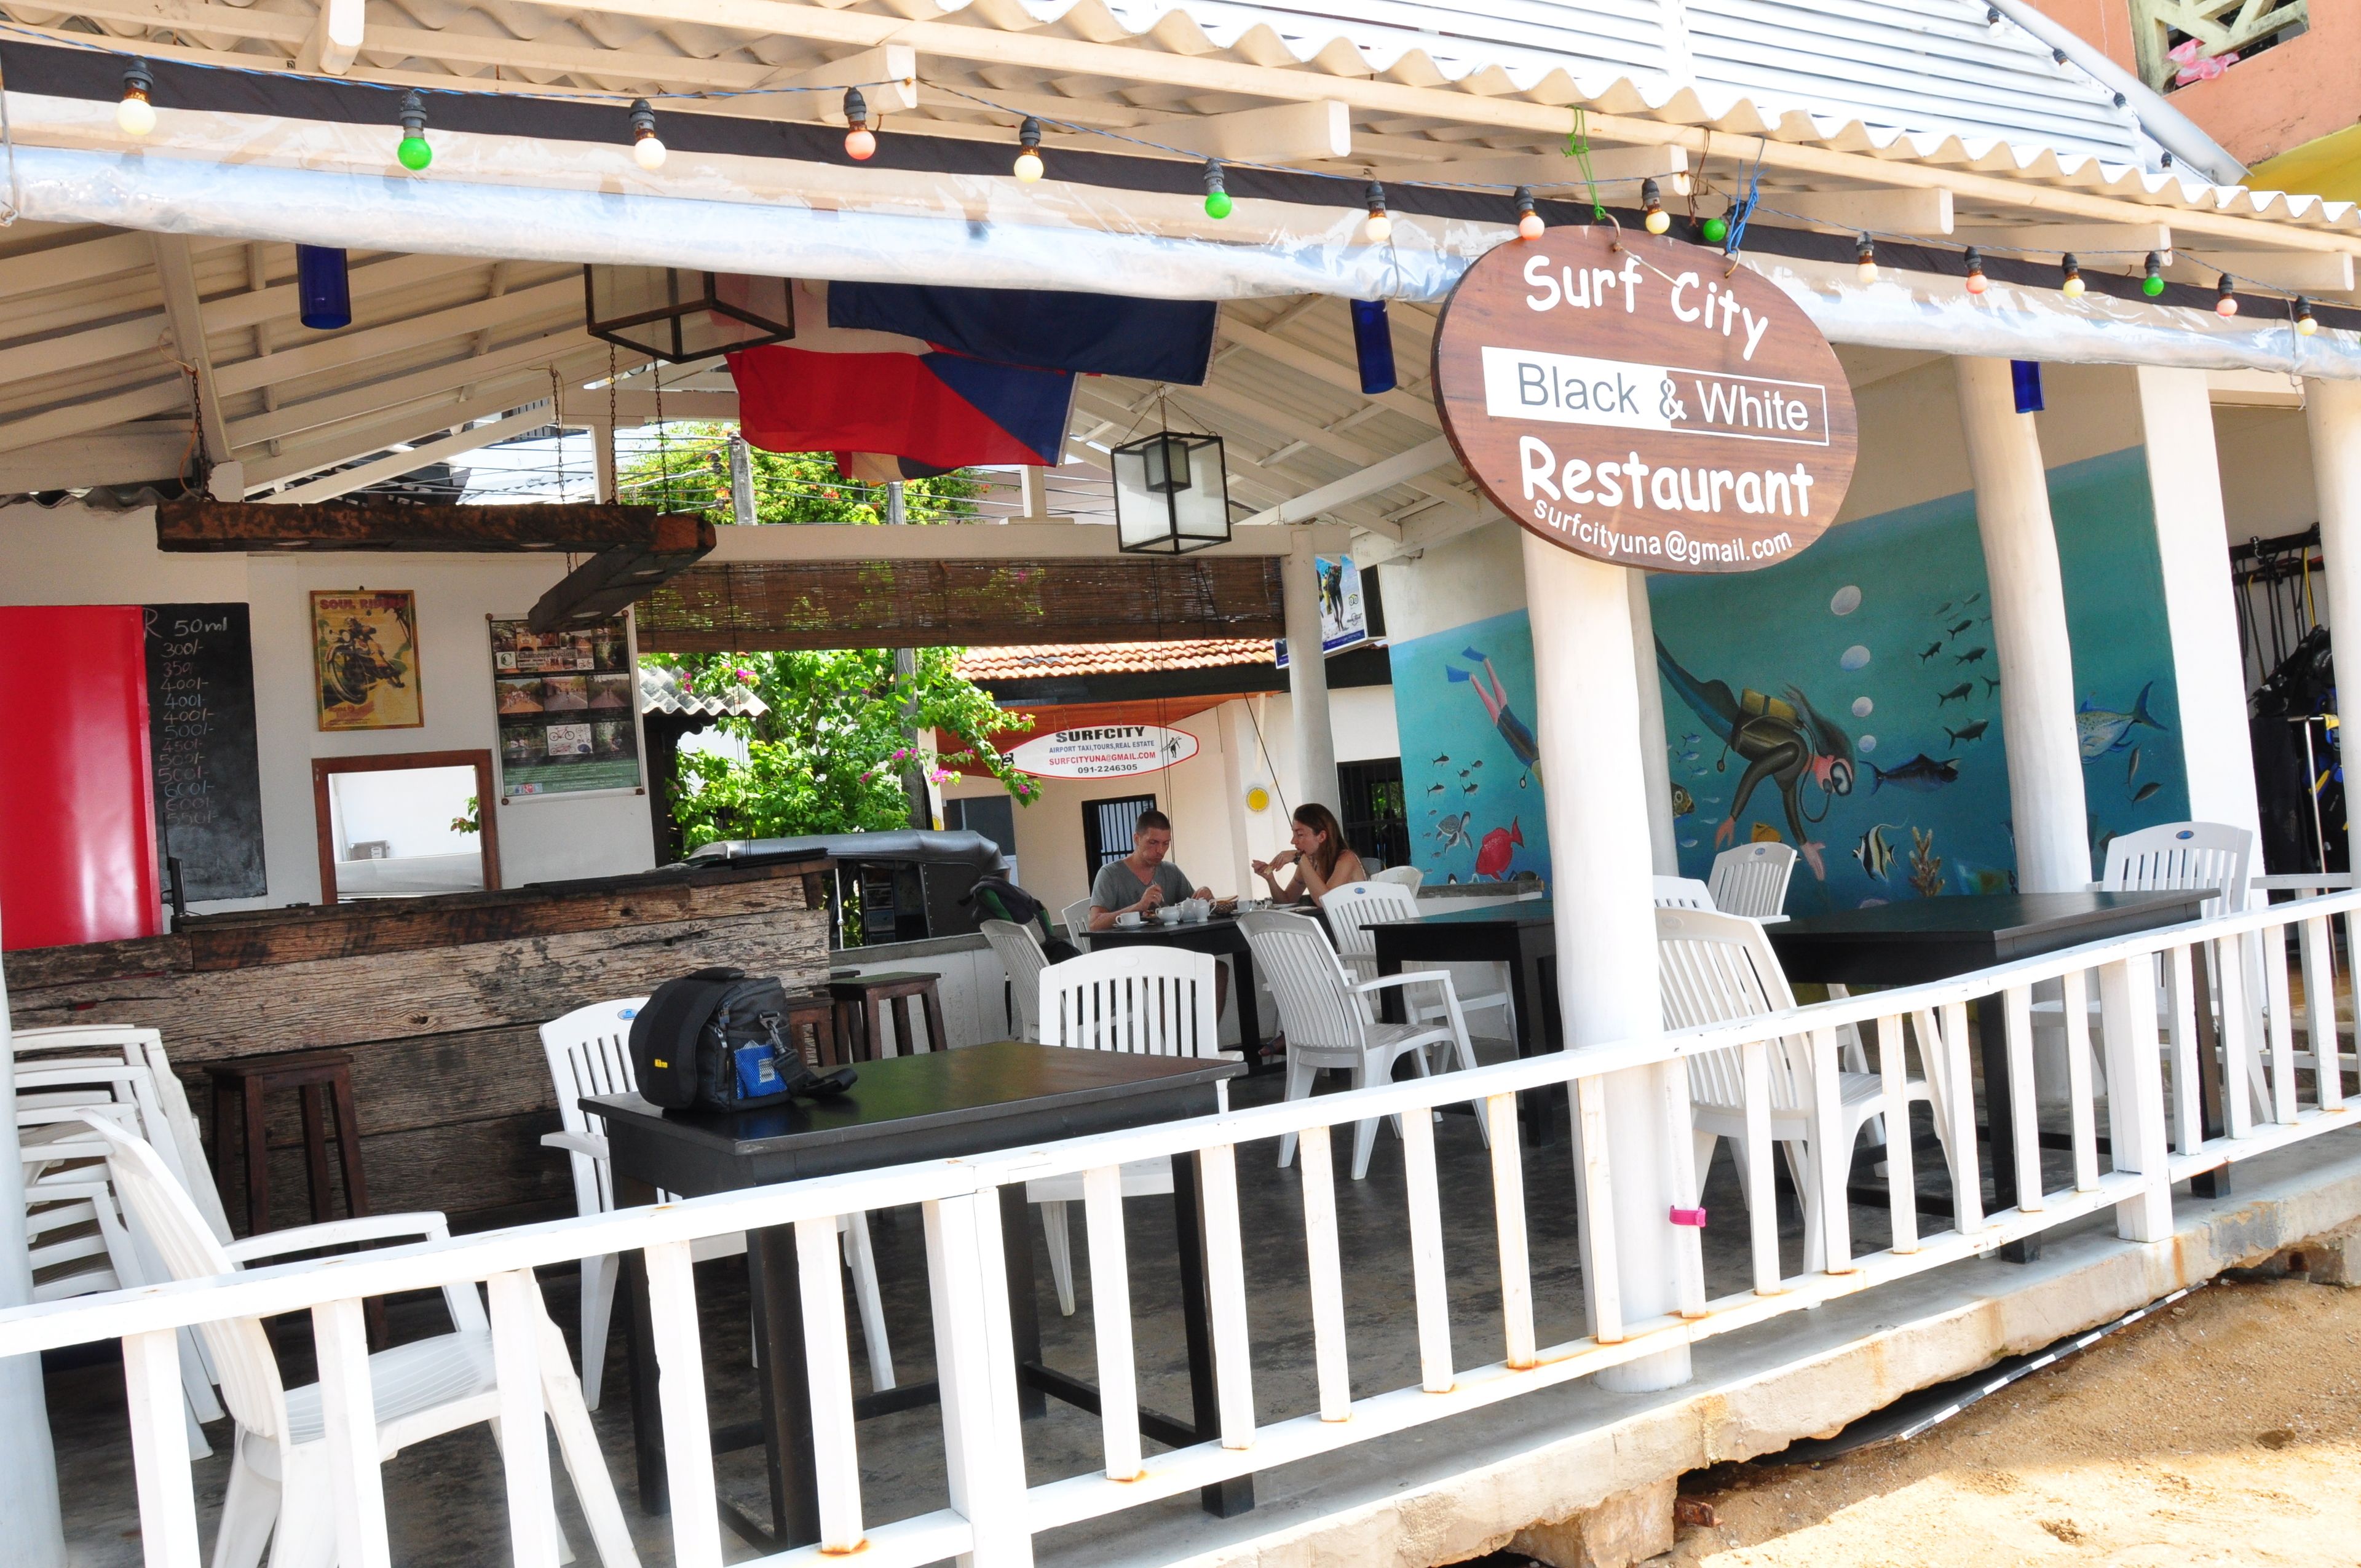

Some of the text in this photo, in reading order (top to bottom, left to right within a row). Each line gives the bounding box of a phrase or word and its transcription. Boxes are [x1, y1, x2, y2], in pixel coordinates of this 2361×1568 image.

[1524, 255, 1769, 361] Surf City
[1517, 362, 1809, 431] Black & White
[1519, 435, 1814, 517] Restaurant
[1533, 499, 1793, 566] surfcityuna@gmail.com
[319, 599, 356, 610] SOUL
[1055, 726, 1145, 743] SURFCITY
[1049, 751, 1156, 766] SURFCITYUNA@GMAIL.COM
[1078, 764, 1137, 774] 091-2246305
